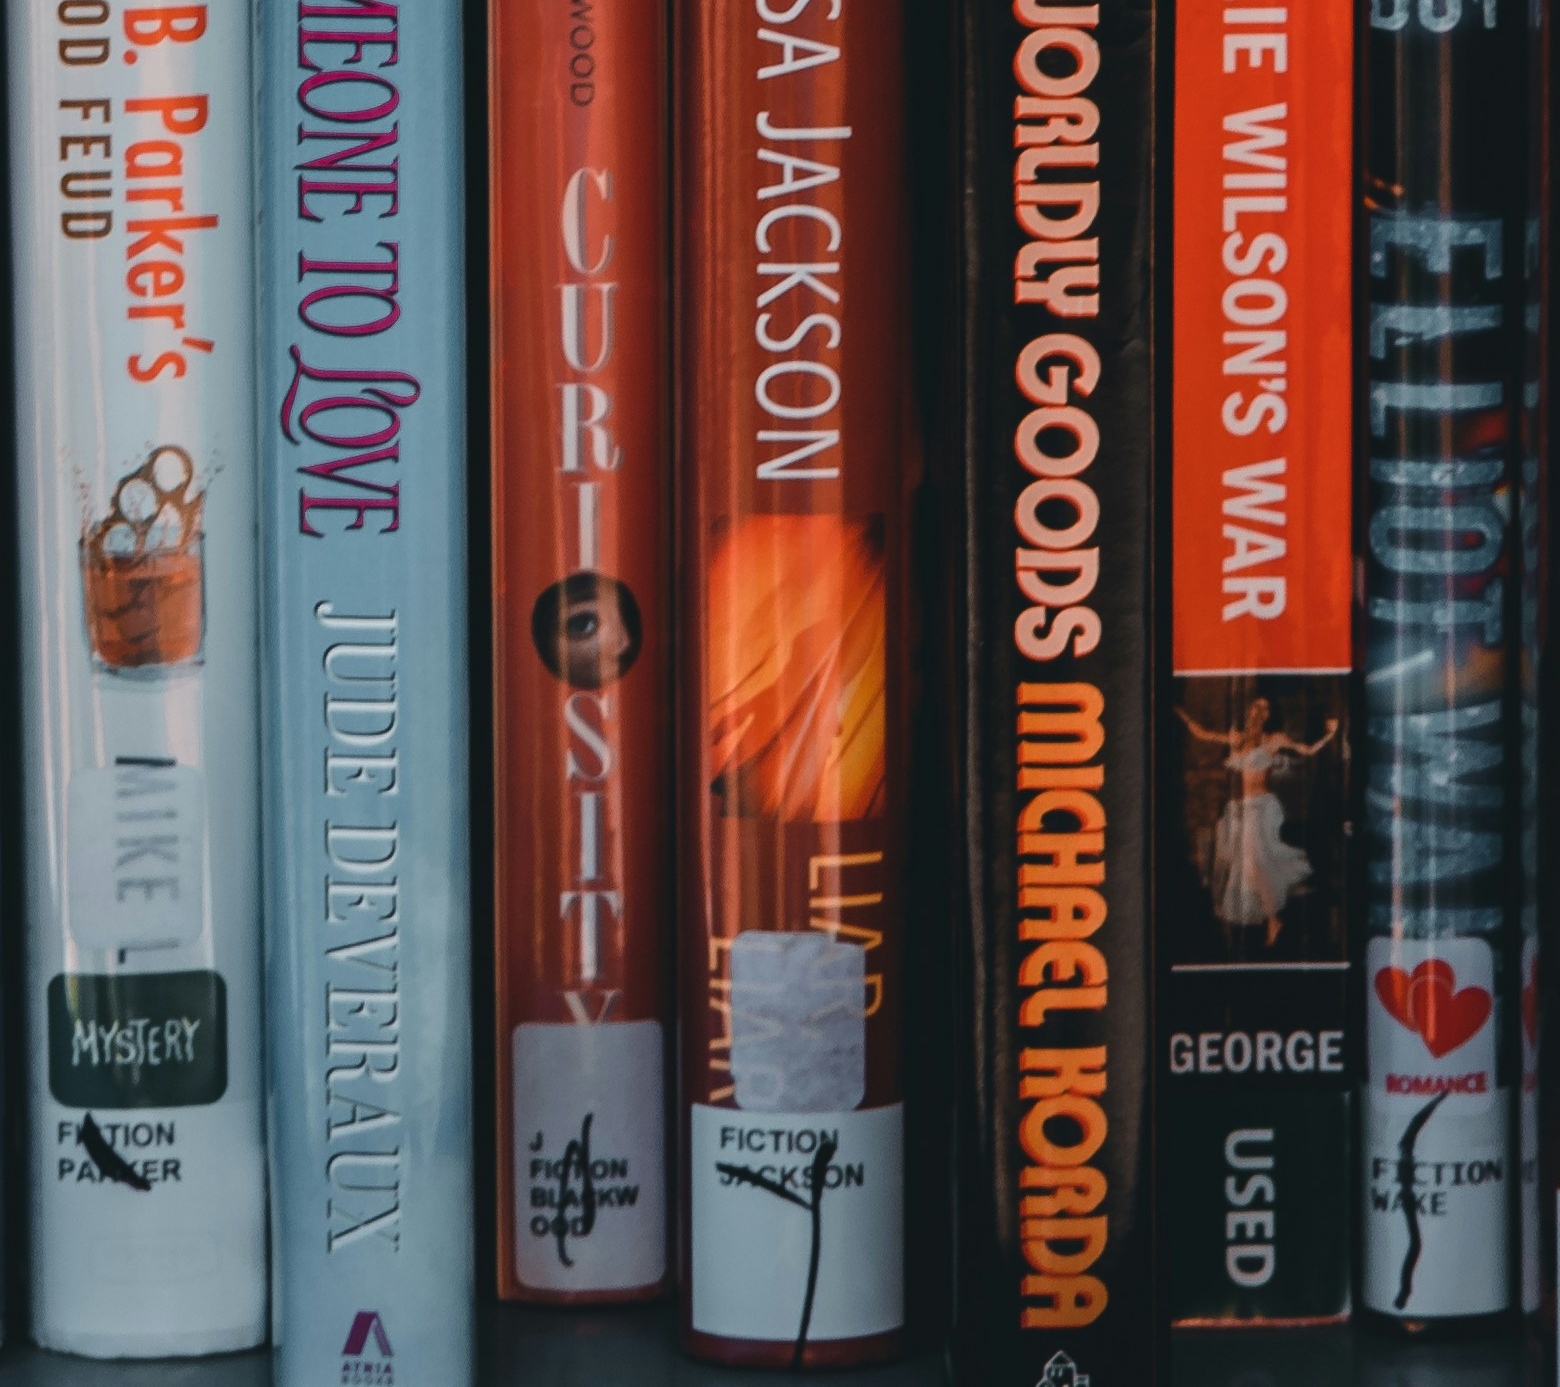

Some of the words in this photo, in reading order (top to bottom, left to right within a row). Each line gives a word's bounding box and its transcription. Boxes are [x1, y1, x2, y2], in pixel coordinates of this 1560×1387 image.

[296, 243, 400, 337] TO
[1221, 102, 1289, 436] WILSON'S
[281, 343, 421, 536] LOVE
[1013, 332, 1101, 660] GOODS
[1220, 458, 1288, 621] WAR
[1015, 681, 1108, 1027] MICHAEL
[1171, 1032, 1343, 1072] GEORGE
[1017, 1047, 1110, 1329] KORDA
[1224, 1129, 1275, 1288] USED
